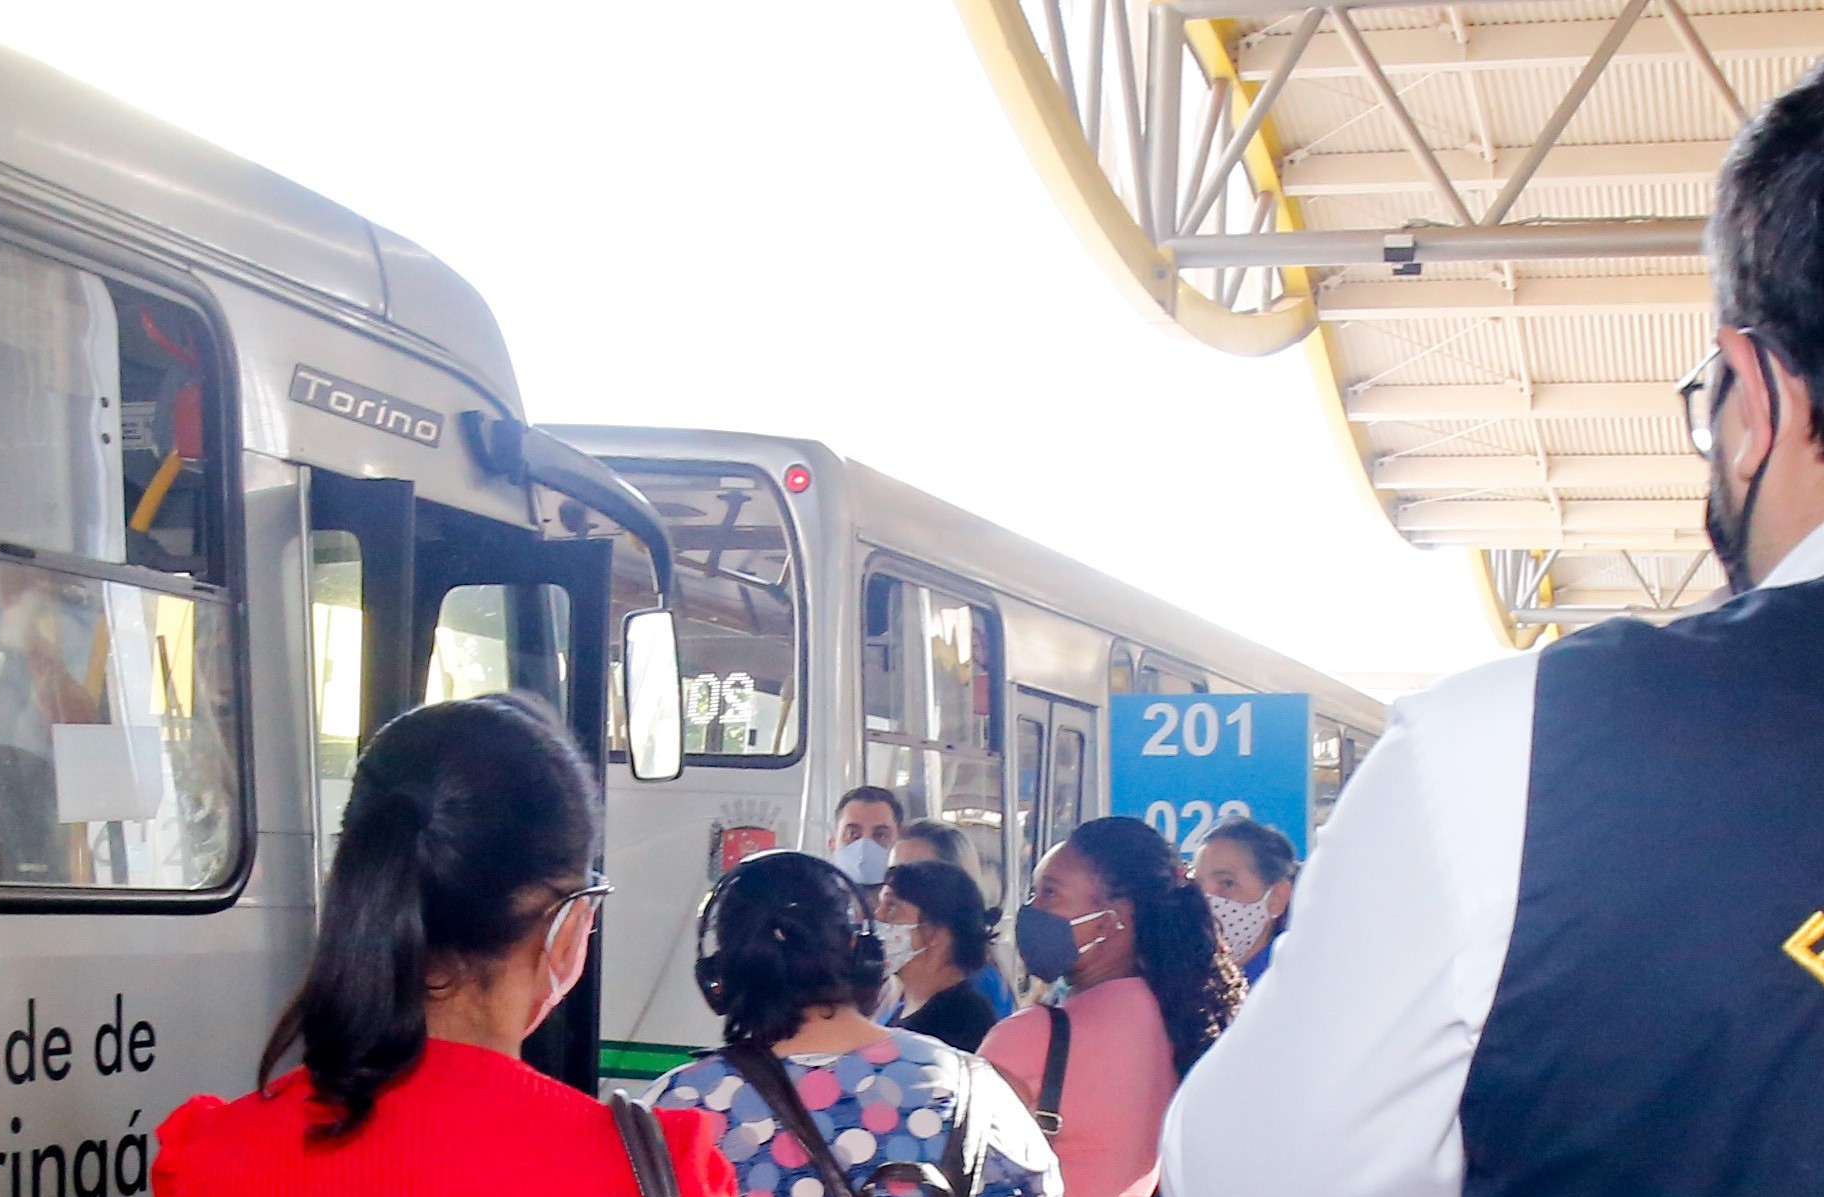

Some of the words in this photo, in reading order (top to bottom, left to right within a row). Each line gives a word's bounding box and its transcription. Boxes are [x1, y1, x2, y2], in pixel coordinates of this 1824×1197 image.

[298, 370, 440, 443] Torino
[1142, 701, 1254, 758] 201
[1144, 799, 1251, 855] 02
[94, 992, 157, 1076] de
